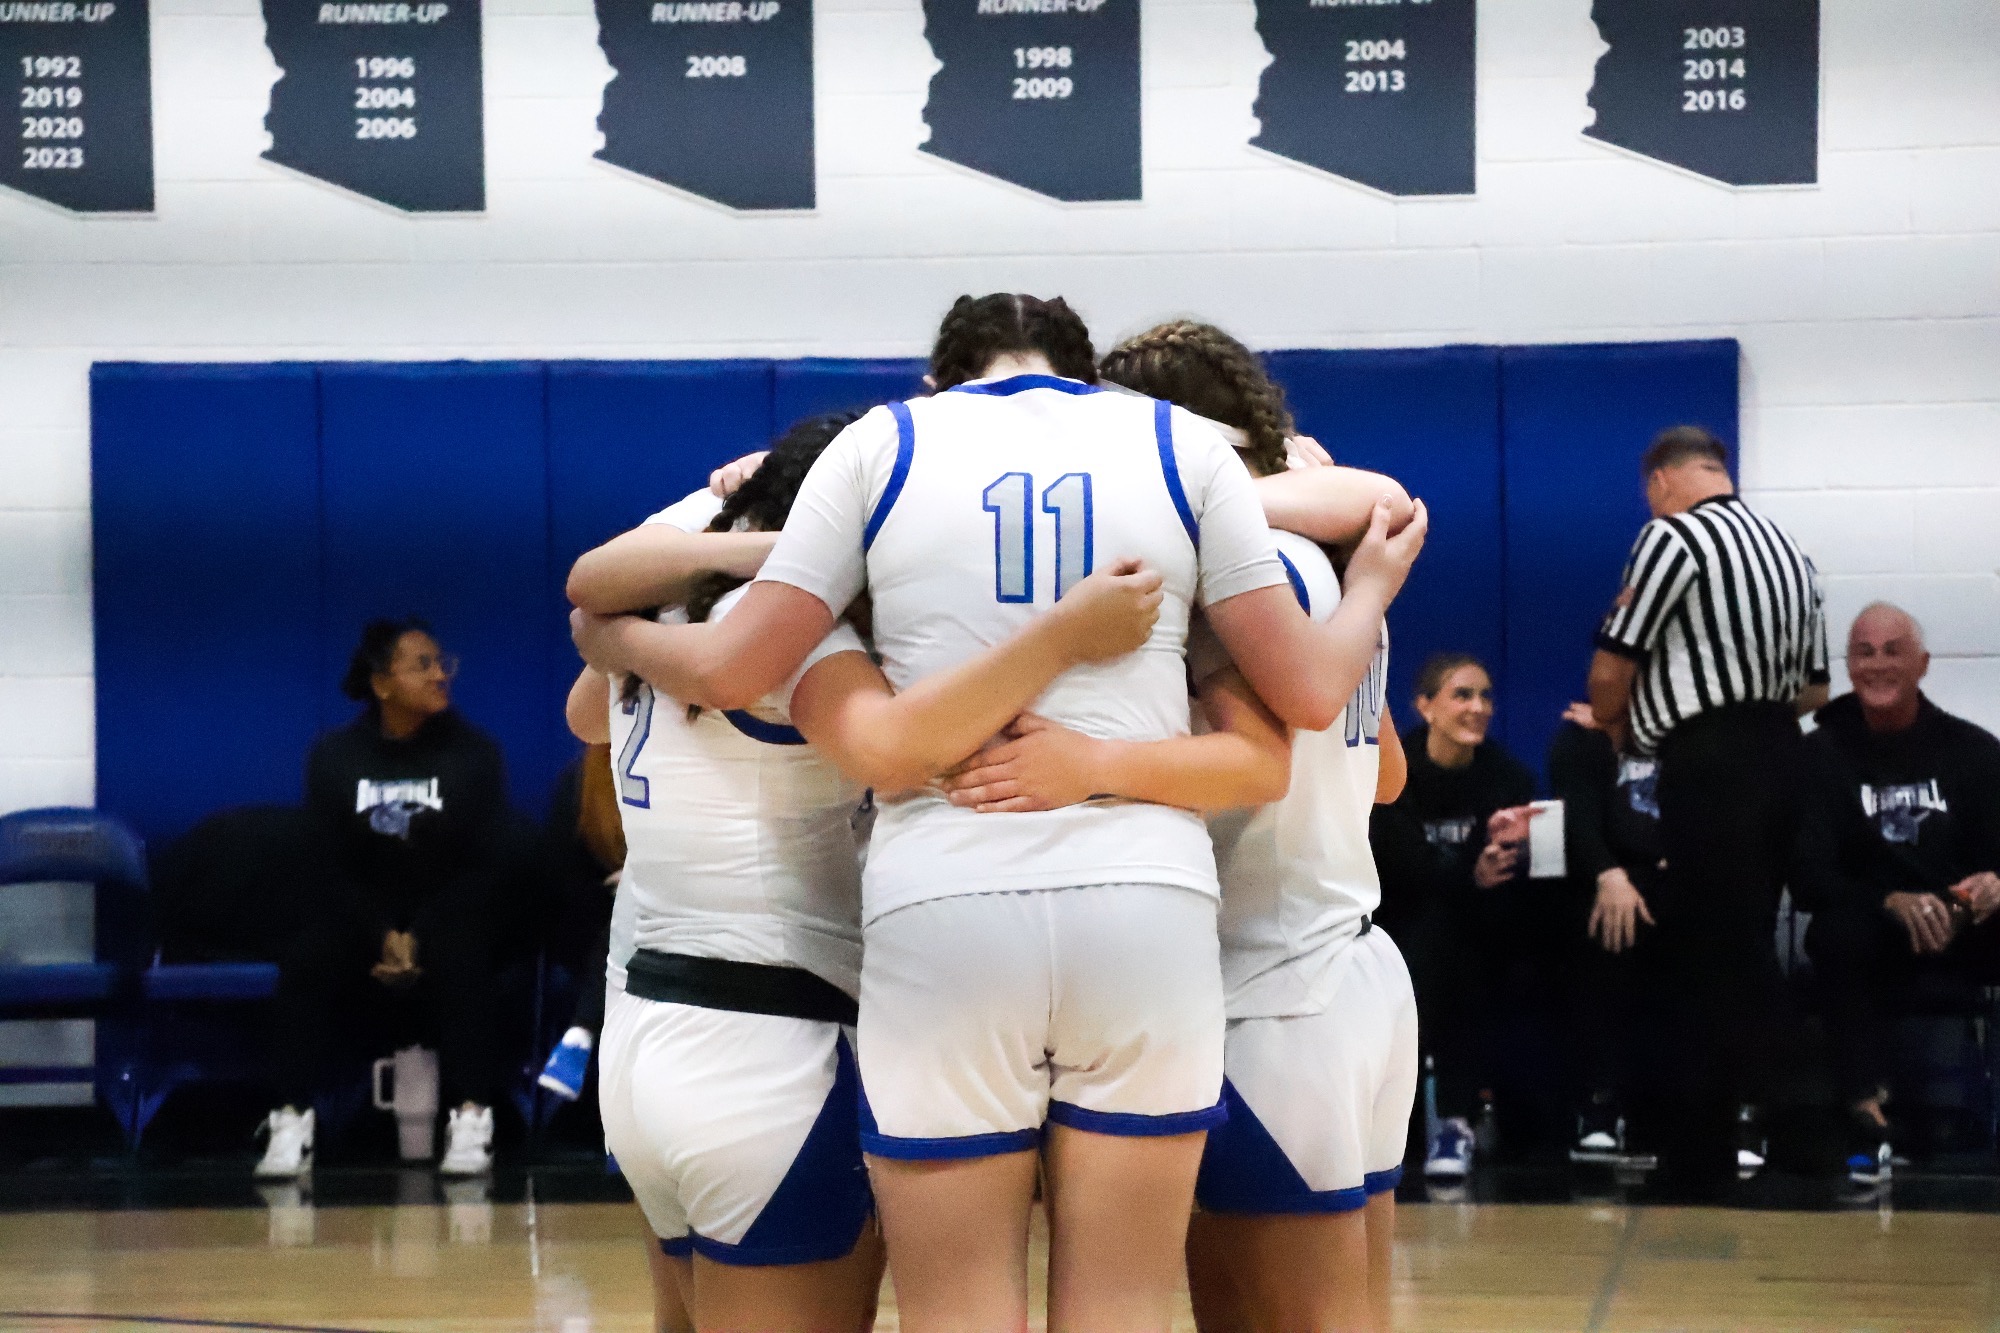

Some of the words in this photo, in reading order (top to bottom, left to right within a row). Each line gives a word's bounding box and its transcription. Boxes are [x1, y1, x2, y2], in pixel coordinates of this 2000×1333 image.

[0, 3, 116, 22] UNNER-UP
[319, 3, 449, 23] RUNNER-UP
[652, 2, 780, 22] RUNNER-UP
[1683, 27, 1745, 49] 2003
[1013, 47, 1072, 68] 1998
[1346, 39, 1406, 61] 2004
[22, 56, 82, 77] 1992
[356, 57, 415, 78] 1996
[685, 55, 747, 78] 2008
[1683, 59, 1746, 80] 2014
[1012, 77, 1073, 99] 2009
[1345, 70, 1405, 92] 2013
[21, 87, 83, 108] 2019
[355, 87, 416, 109] 2004
[1683, 89, 1746, 111] 2016
[22, 117, 84, 138] 2020
[356, 117, 417, 139] 2006
[23, 147, 84, 168] 2023
[982, 472, 1093, 603] 11
[618, 681, 655, 809] 2
